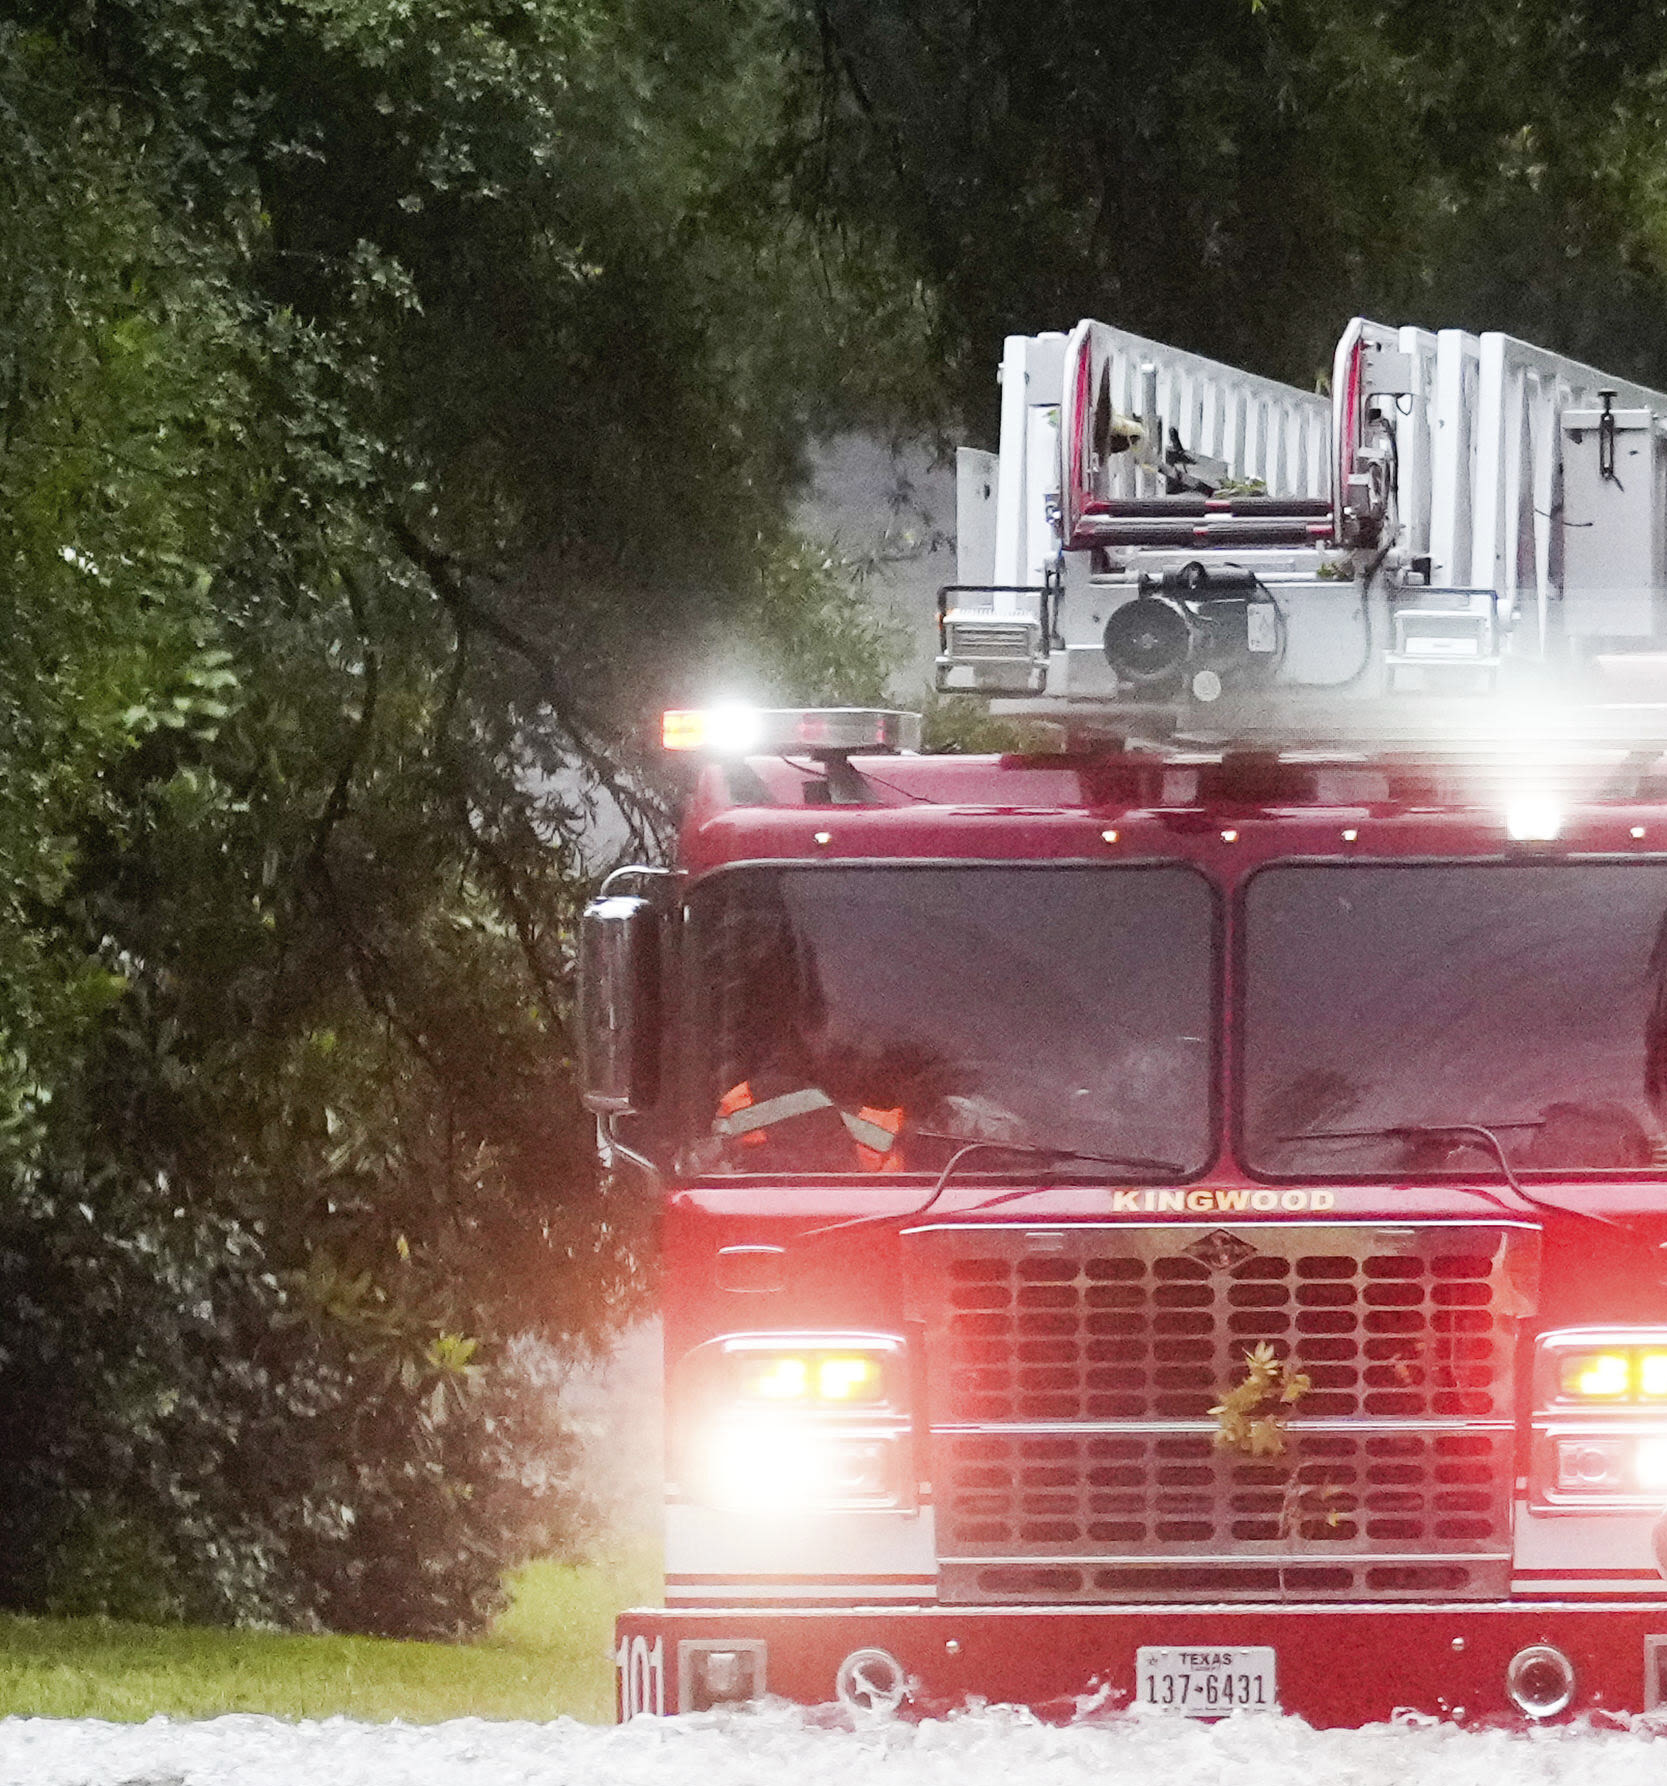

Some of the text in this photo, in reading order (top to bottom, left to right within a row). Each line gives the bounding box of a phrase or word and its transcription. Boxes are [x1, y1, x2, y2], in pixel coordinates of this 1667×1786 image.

[1111, 1189, 1335, 1213] KINGWOOD
[1179, 1652, 1233, 1665] TEXAS
[615, 1634, 663, 1721] 101
